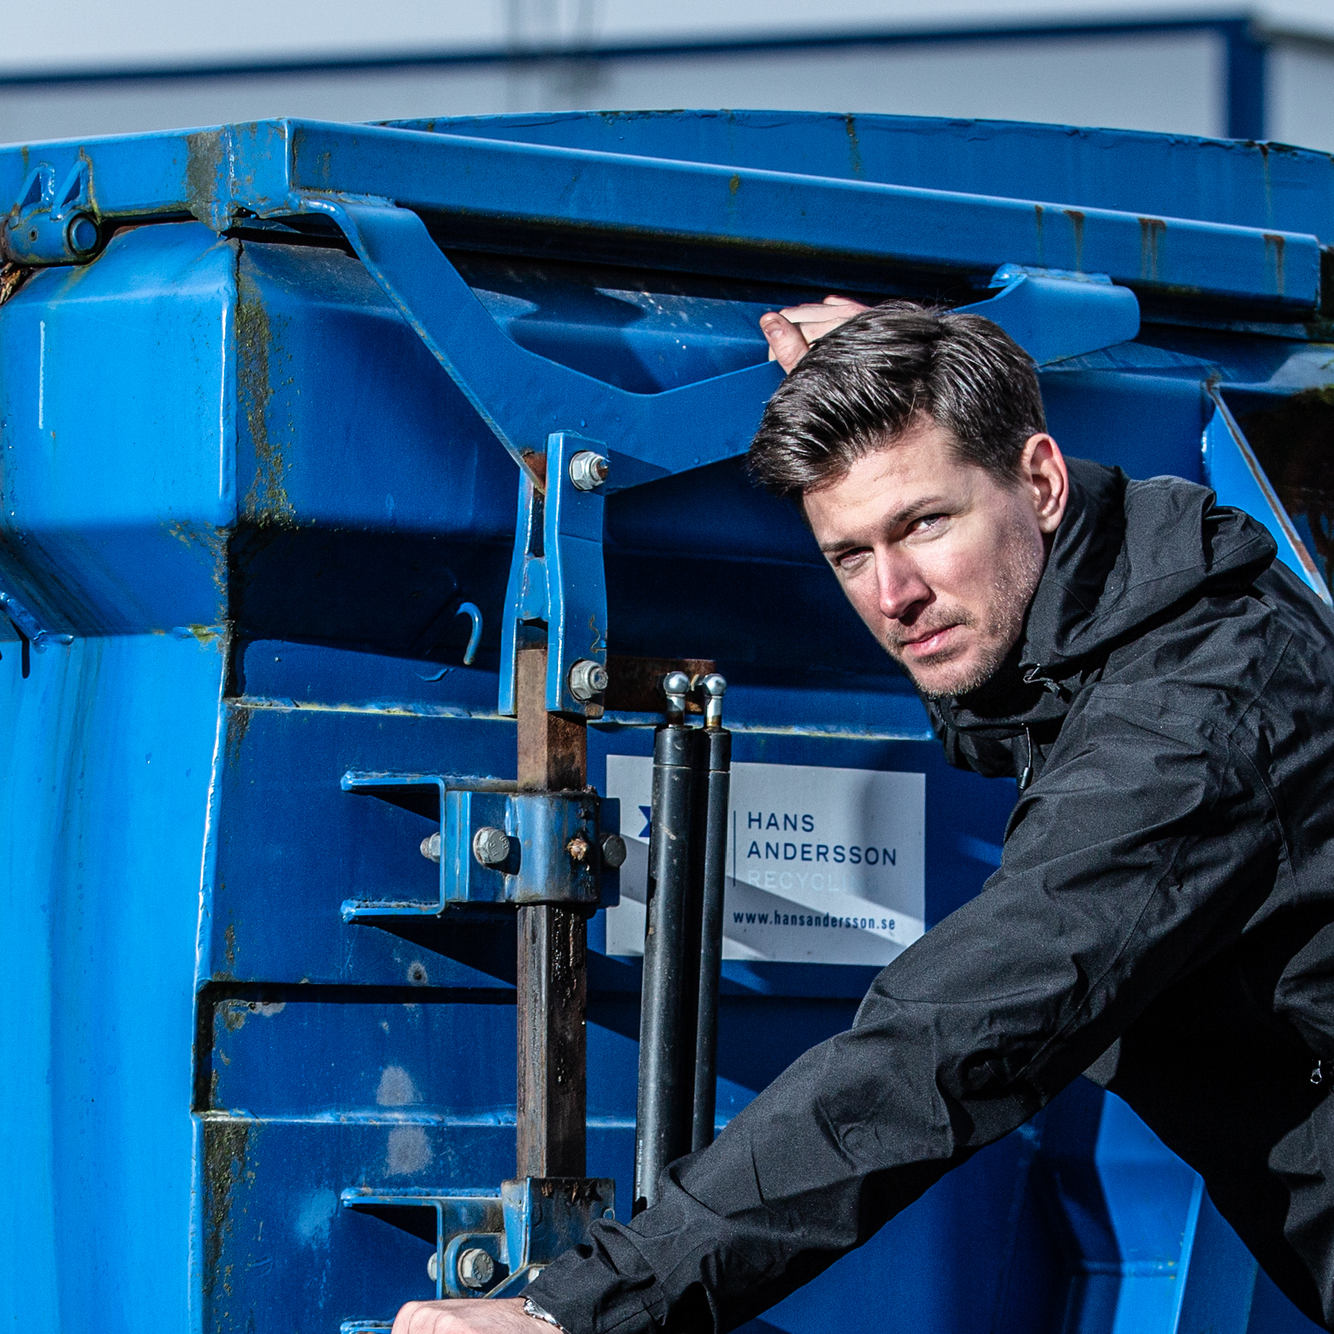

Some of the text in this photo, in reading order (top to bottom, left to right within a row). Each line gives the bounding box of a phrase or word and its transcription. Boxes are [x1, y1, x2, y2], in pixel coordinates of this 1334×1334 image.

[748, 811, 815, 833] HANS
[747, 840, 897, 867] ANDERSSON
[733, 909, 896, 931] www.hansandersson.se
